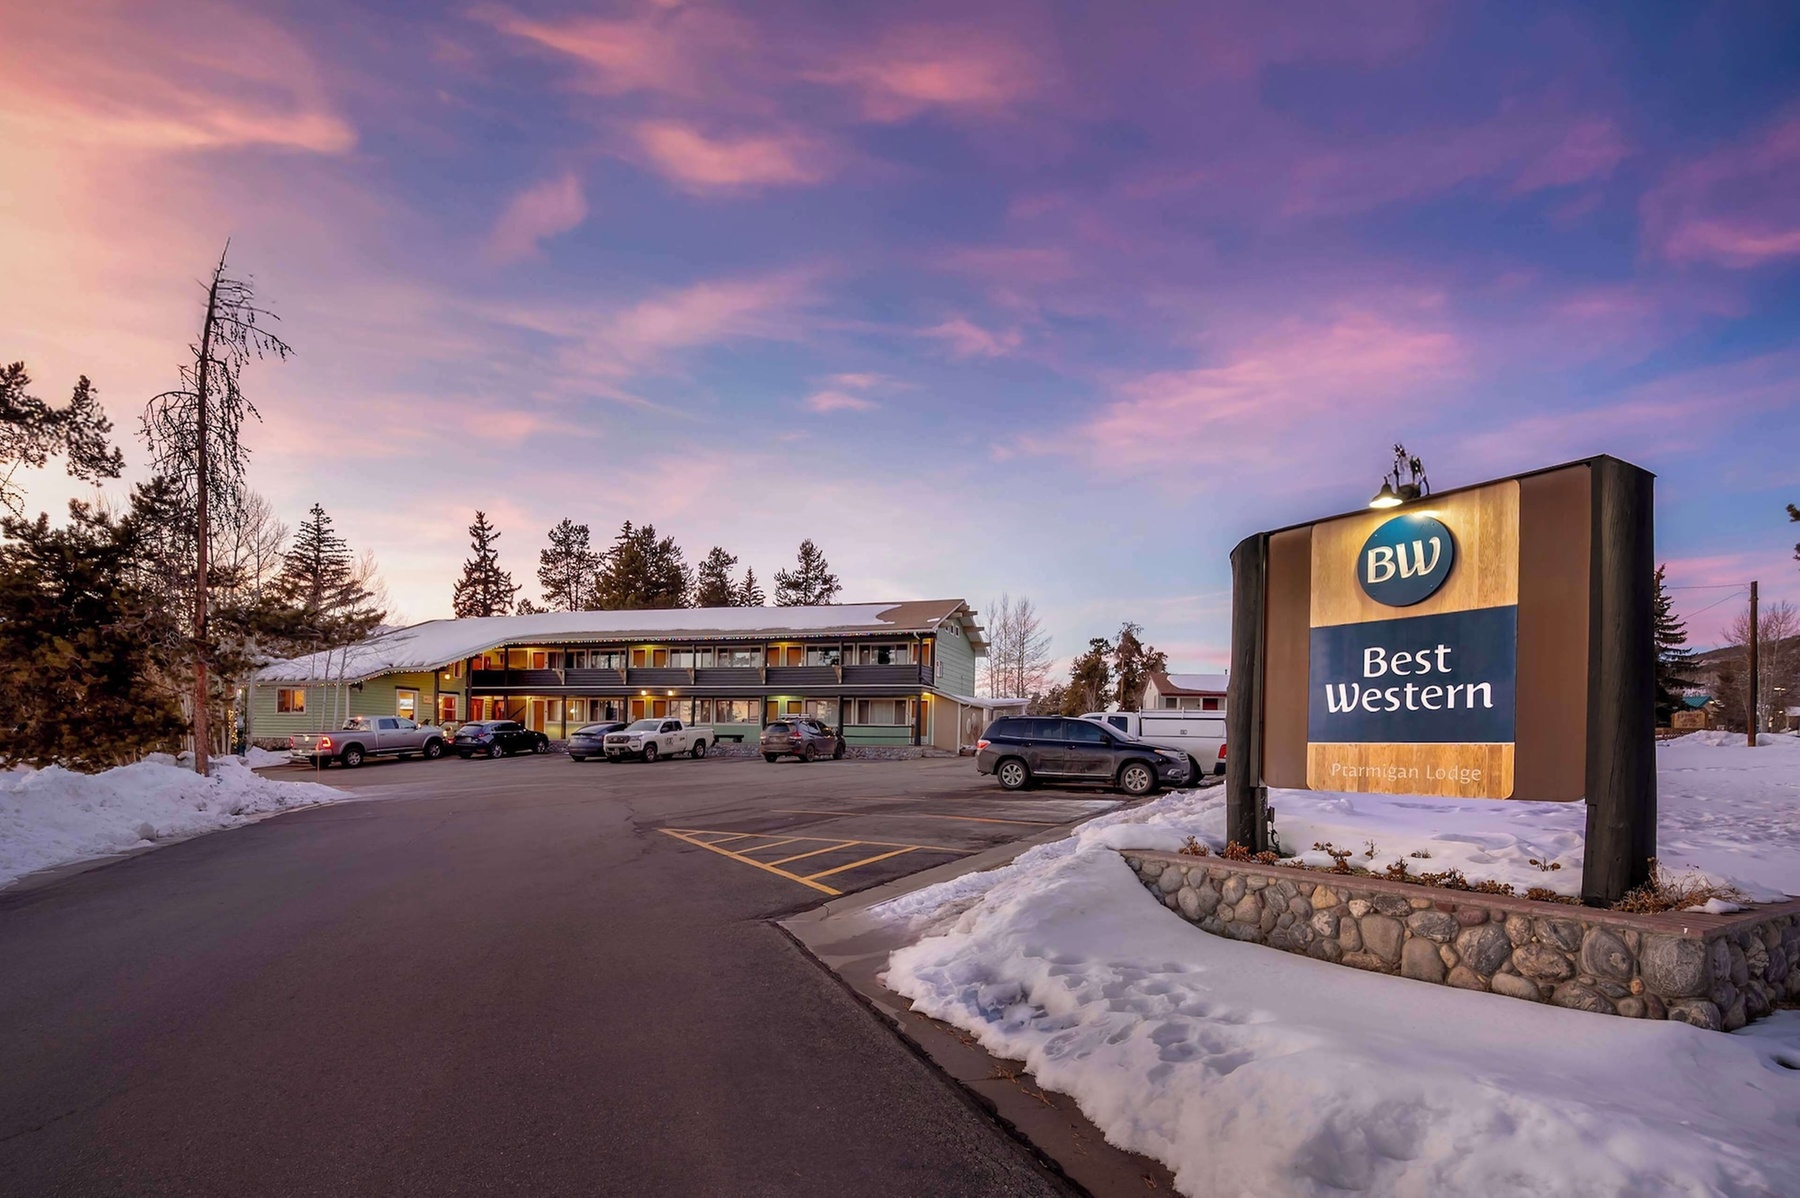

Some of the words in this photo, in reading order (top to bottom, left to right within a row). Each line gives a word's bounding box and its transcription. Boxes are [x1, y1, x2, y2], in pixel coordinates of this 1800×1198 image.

[1367, 536, 1441, 584] BW
[1363, 644, 1452, 678] Best
[1325, 681, 1494, 713] Western
[1331, 762, 1419, 782] Ptarmigan
[1426, 765, 1482, 784] Lodge
